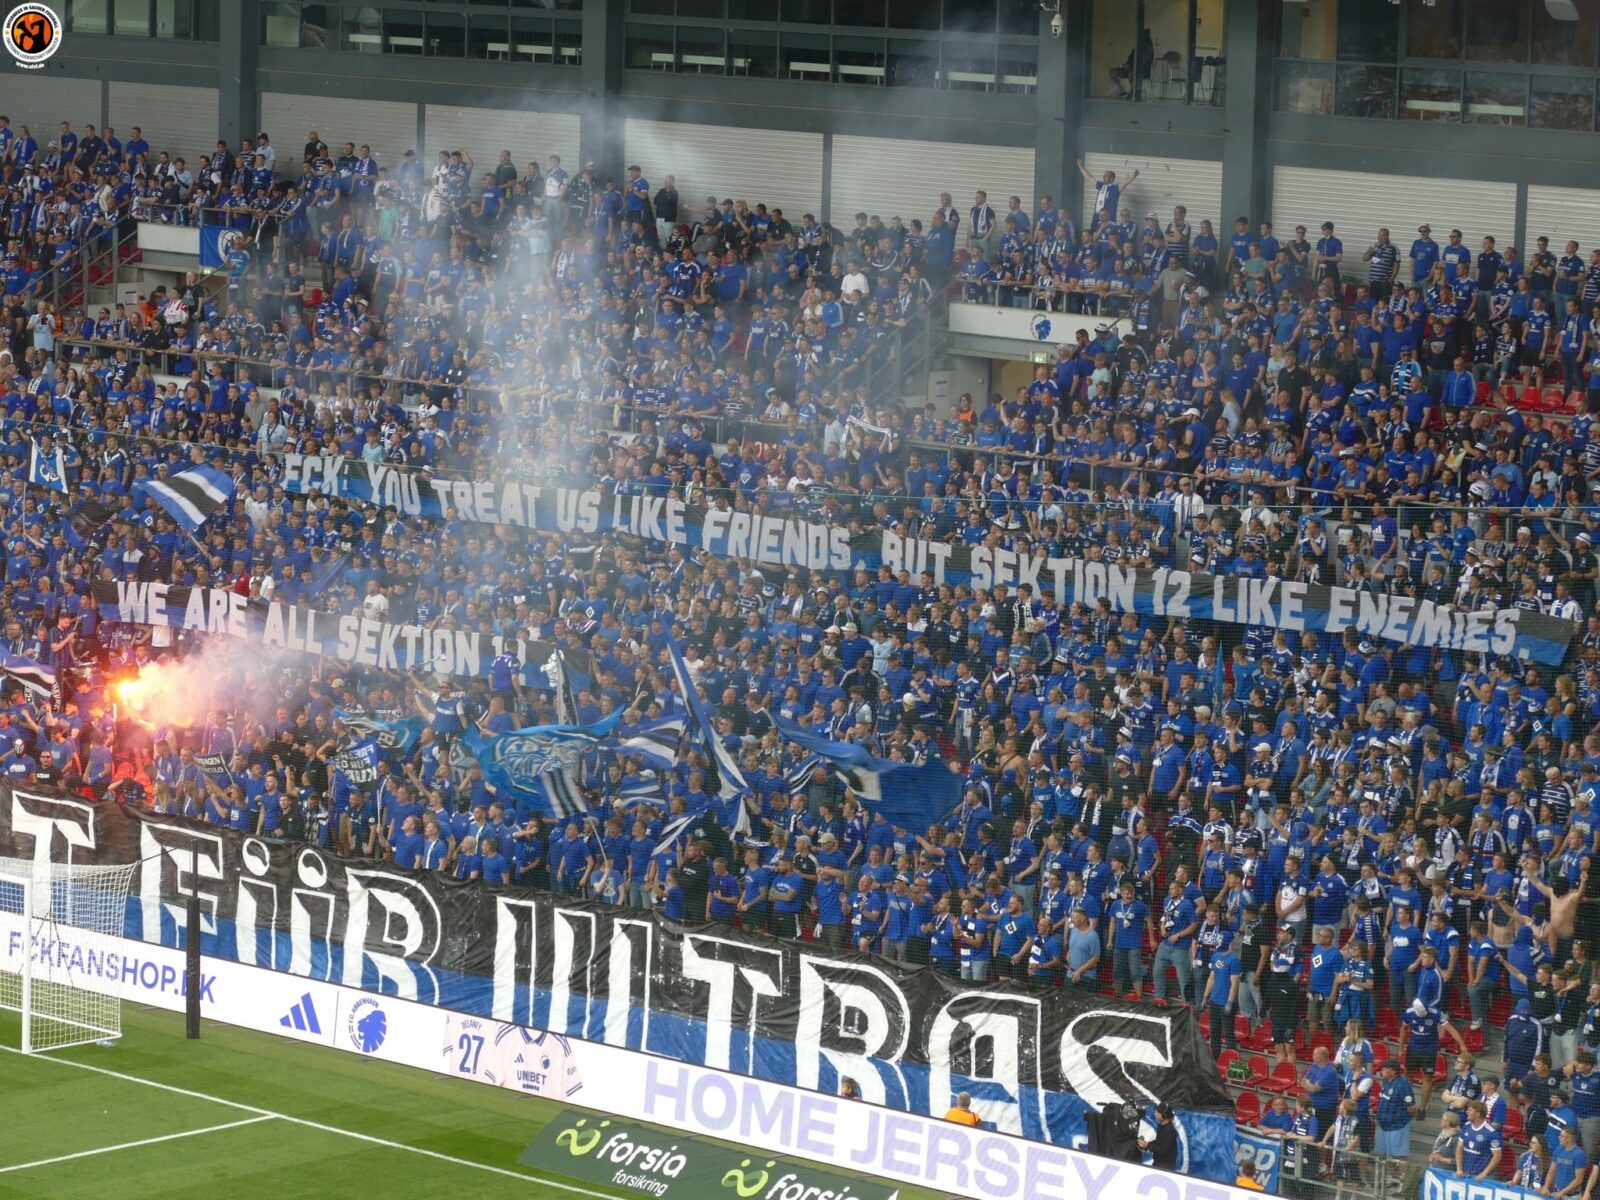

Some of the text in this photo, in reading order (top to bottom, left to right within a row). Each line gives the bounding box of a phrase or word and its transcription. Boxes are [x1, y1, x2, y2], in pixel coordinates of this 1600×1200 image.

[367, 463, 421, 515] YOU
[430, 479, 541, 529] TREAT
[557, 488, 601, 534] US
[612, 494, 686, 544] LIKE
[882, 530, 952, 586] BUT
[971, 547, 1136, 612] SEKTION
[1152, 568, 1191, 616] 12
[1213, 575, 1307, 630] LIKE
[1325, 586, 1530, 660] ENEMIES.
[117, 581, 168, 626] WE
[183, 587, 248, 639] ARE
[263, 602, 322, 654] ALL
[337, 615, 480, 676] SEKTION
[9, 930, 217, 1003] FCKFANSHOP.K
[461, 1019, 482, 1030] DELANEY
[488, 895, 1190, 1178] ULTRAS
[458, 1033, 485, 1074] 27
[516, 1070, 547, 1086] UNIBET
[643, 1061, 1122, 1200] HOME JERSEY
[596, 1132, 688, 1179] forsia
[1233, 1140, 1276, 1171] RD
[611, 1169, 668, 1197] forsikring
